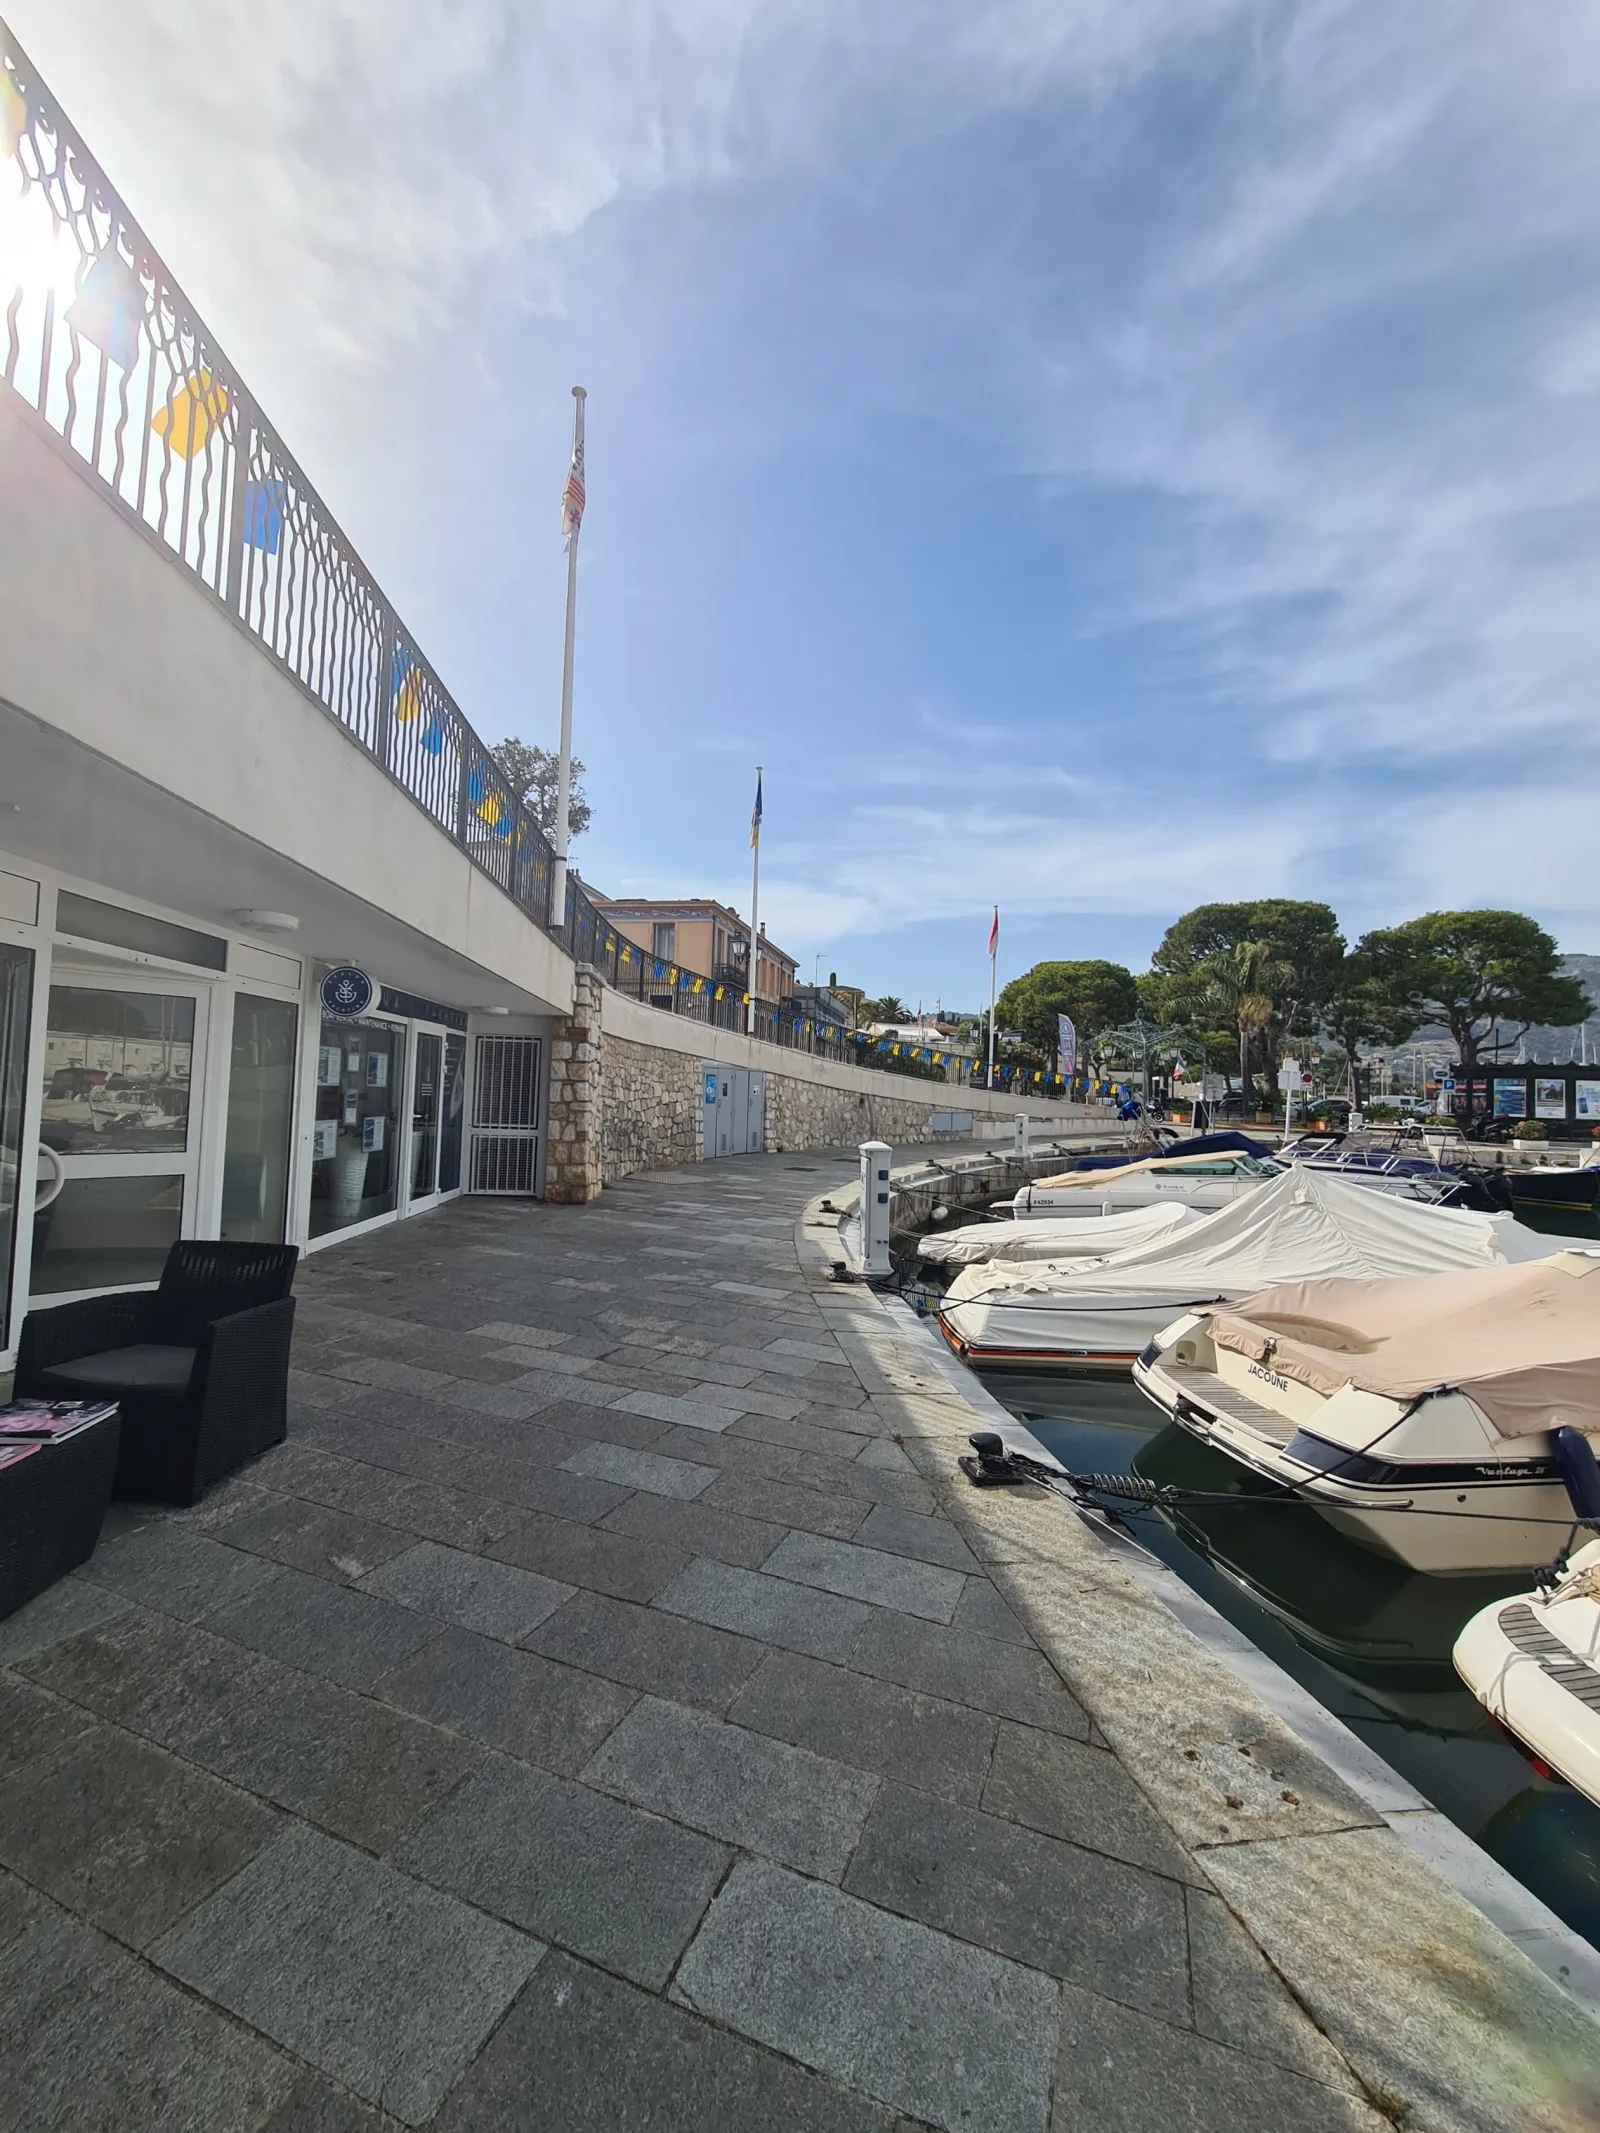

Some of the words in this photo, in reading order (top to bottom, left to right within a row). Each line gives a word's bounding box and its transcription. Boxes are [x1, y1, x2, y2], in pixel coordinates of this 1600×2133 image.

[358, 1018, 388, 1031] MAINTENANCE
[1247, 1363, 1288, 1392] JACOUNE
[1475, 1467, 1533, 1477] Vantage
